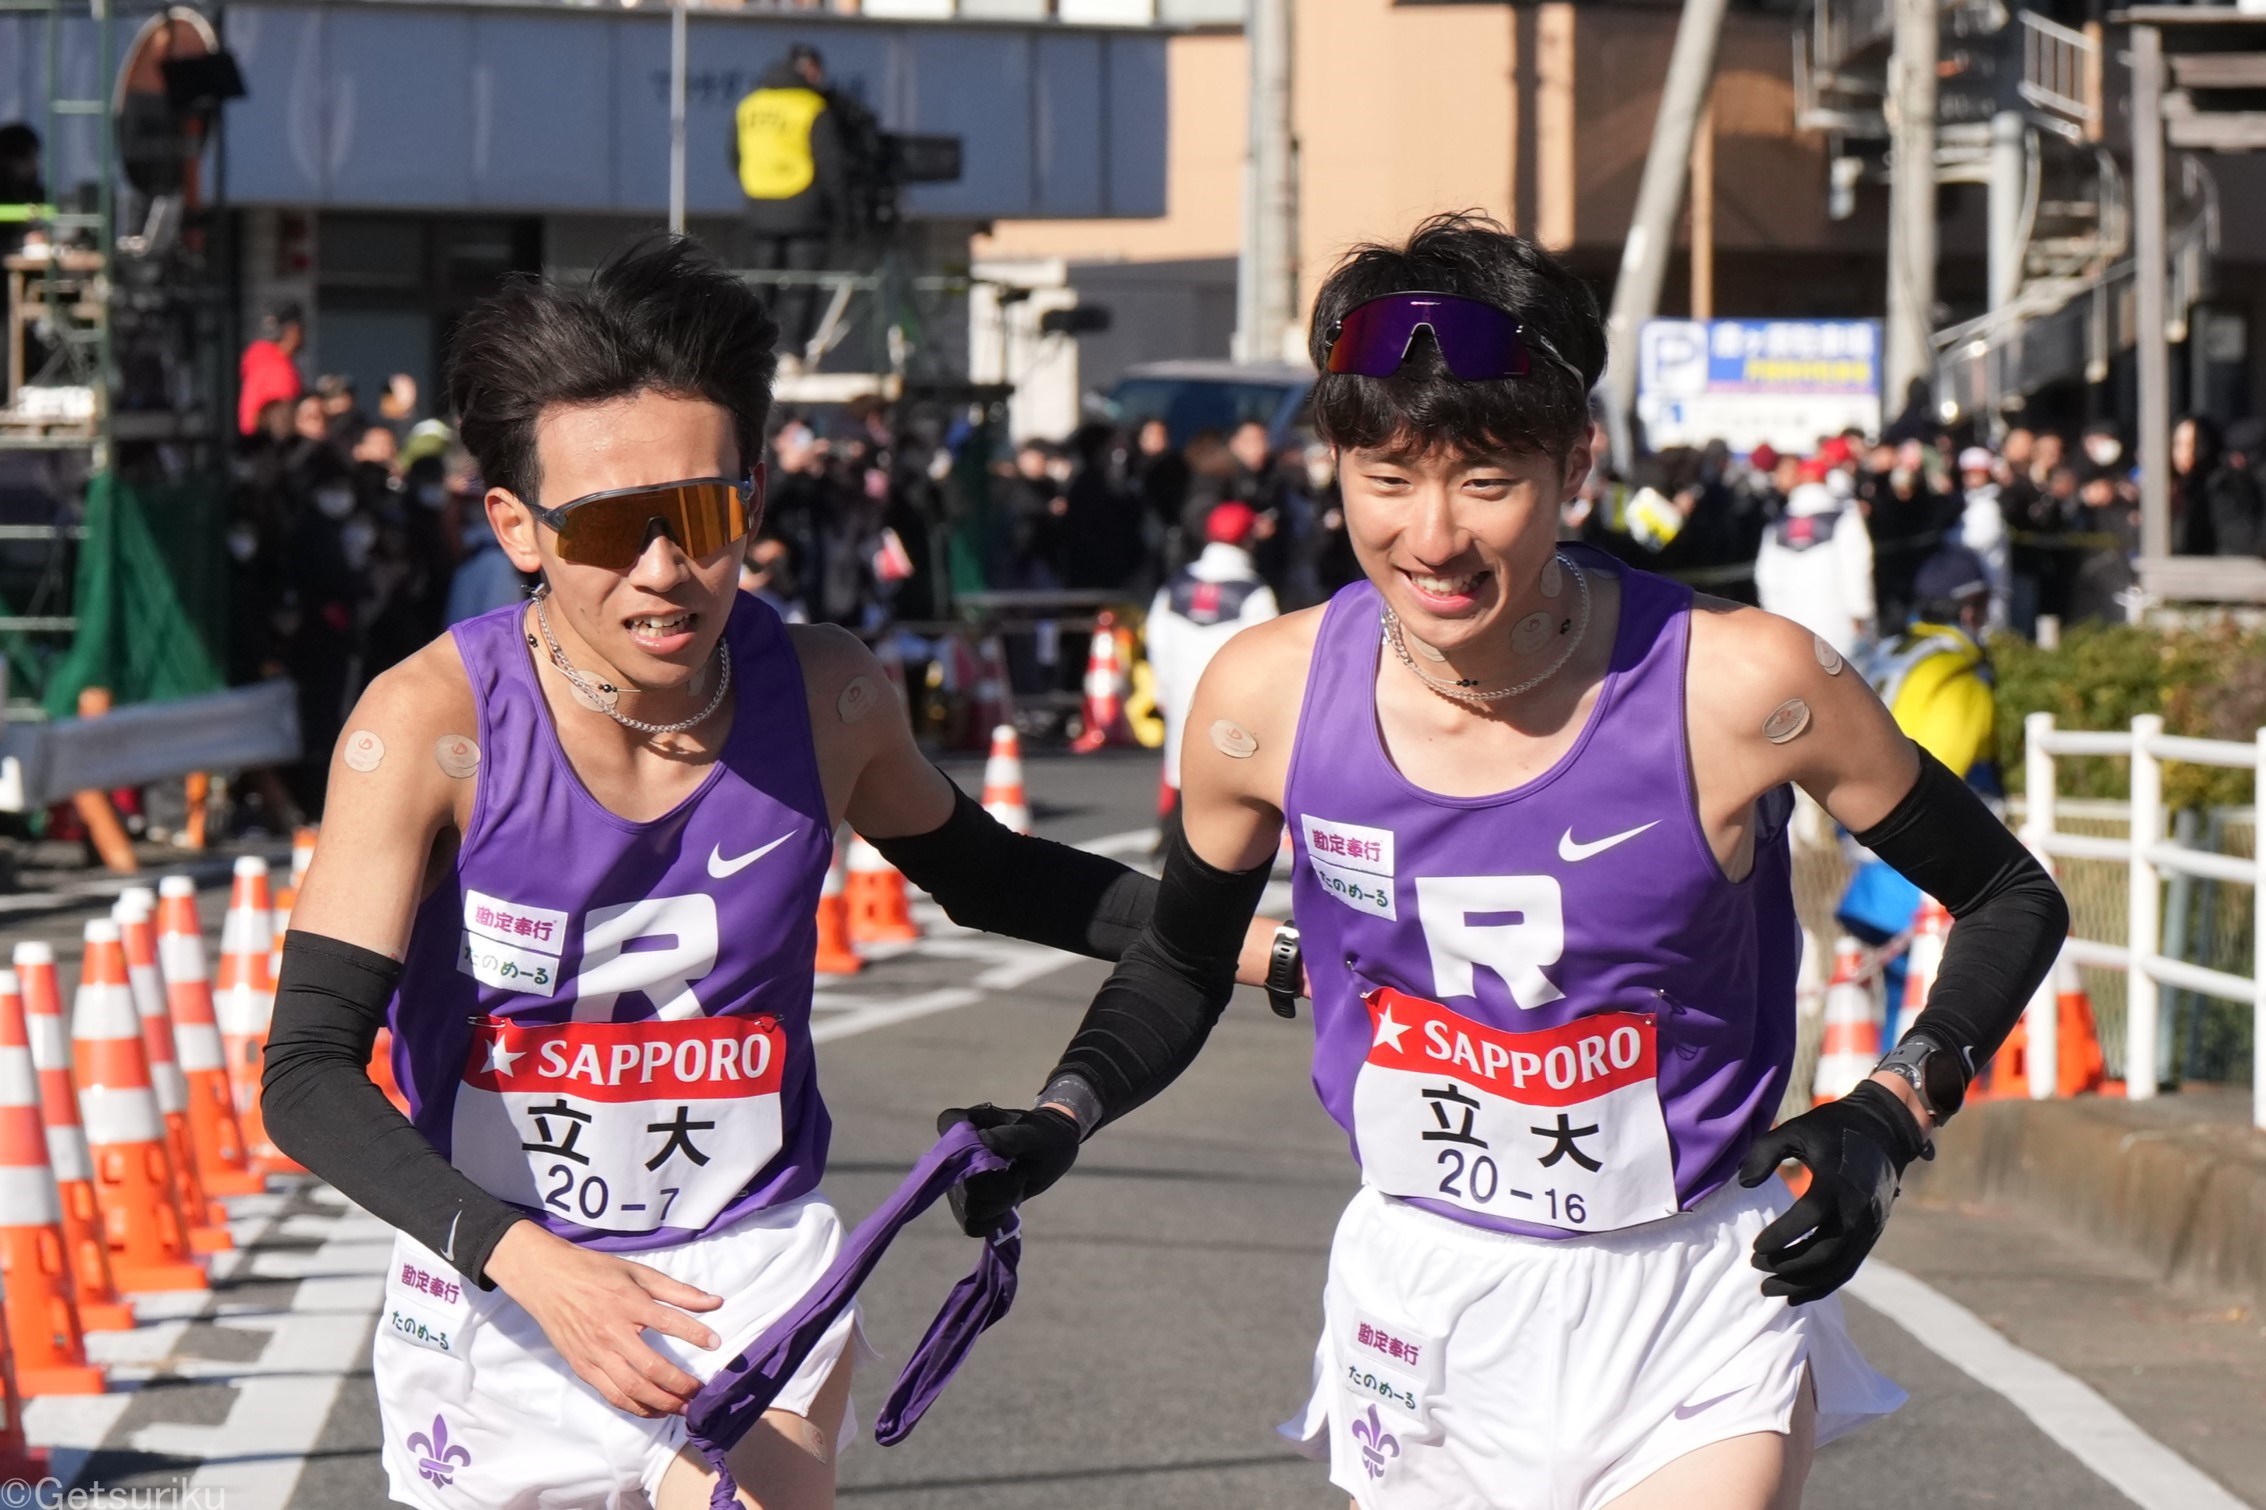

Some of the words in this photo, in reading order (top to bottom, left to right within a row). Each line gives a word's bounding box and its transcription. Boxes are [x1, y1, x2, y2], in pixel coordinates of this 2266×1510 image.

[1312, 828, 1381, 862] 勘定奉行
[1319, 871, 1389, 908] たのめーる
[475, 904, 553, 941] 勘定奉行
[1415, 874, 1566, 1010] R
[464, 946, 549, 985] たのめーる
[571, 893, 719, 1022] R
[537, 1033, 771, 1086] SAPPORO
[1423, 1019, 1642, 1091] SAPPORO
[401, 1263, 460, 1305] 勘定奉行
[392, 1311, 450, 1351] たのめーる
[1357, 1321, 1420, 1366] 勘定奉行
[1348, 1365, 1416, 1410] たのめーる
